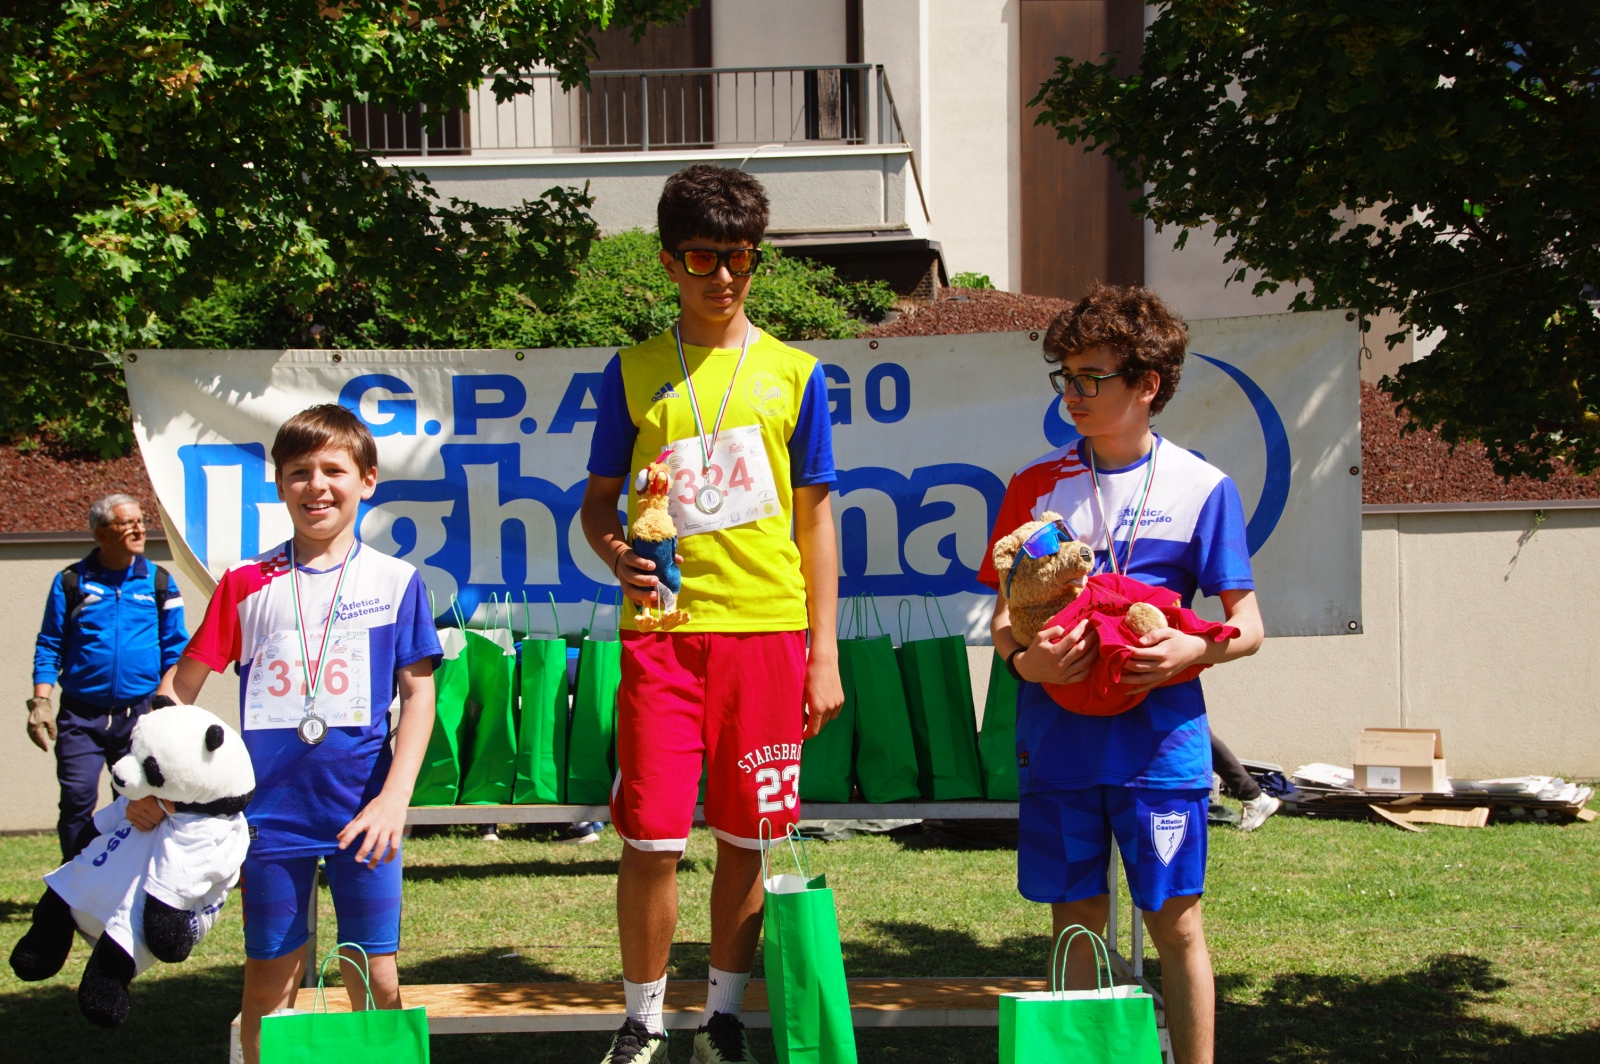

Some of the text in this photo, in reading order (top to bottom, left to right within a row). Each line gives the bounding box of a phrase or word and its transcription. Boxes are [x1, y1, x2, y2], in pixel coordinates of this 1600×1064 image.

[651, 391, 680, 403] adidas
[675, 456, 755, 505] 324
[339, 603, 391, 621] Castenaso
[341, 597, 380, 612] Atletica
[267, 658, 349, 698] 376
[756, 764, 800, 814] 23
